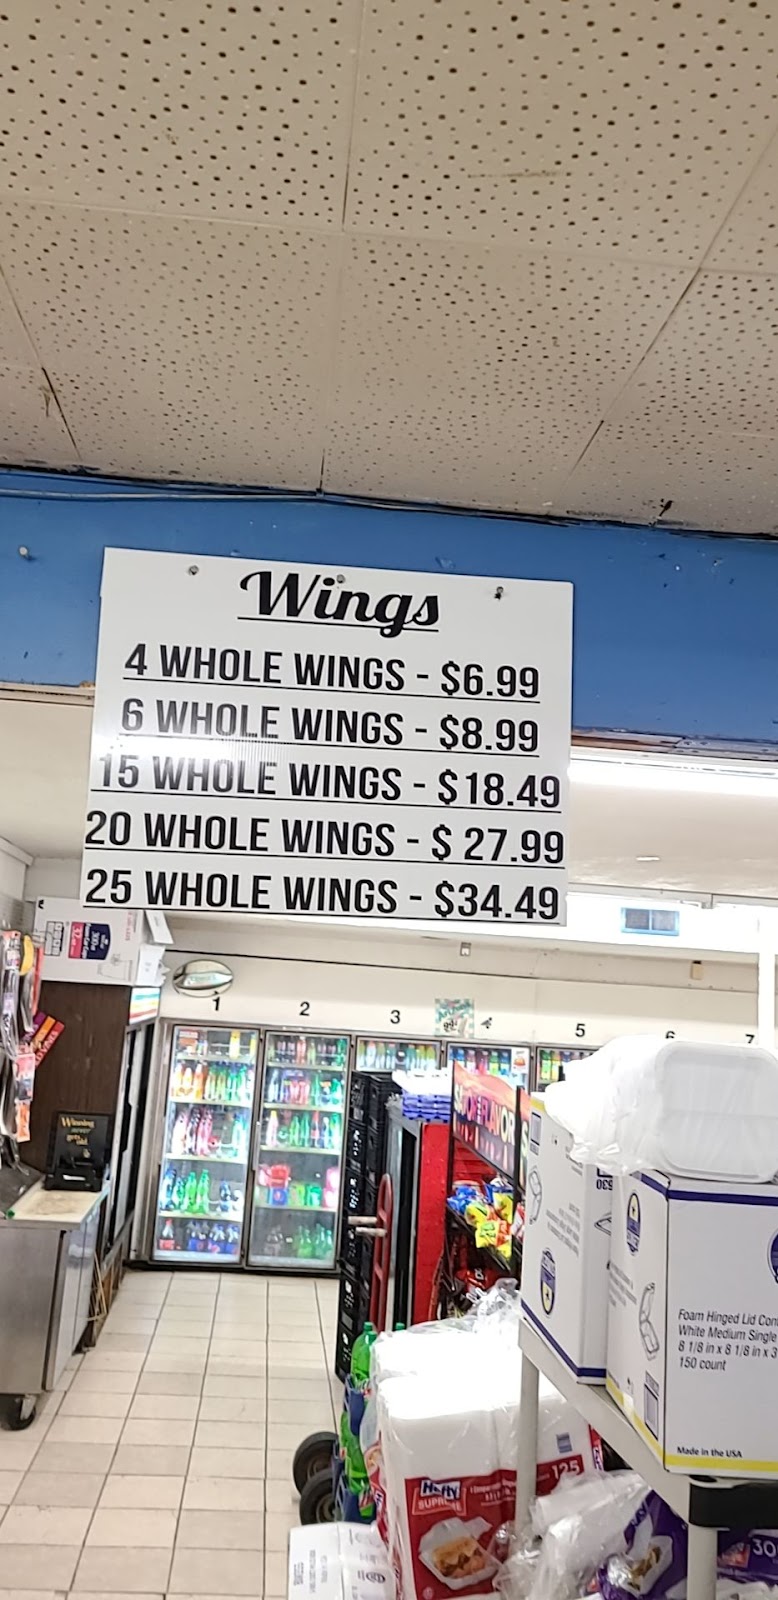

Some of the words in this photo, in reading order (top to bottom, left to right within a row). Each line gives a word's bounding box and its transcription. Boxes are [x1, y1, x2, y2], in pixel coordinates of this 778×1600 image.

[240, 571, 439, 638] Wings
[125, 644, 147, 675] 4
[160, 645, 283, 684] WHOLE
[295, 653, 406, 691] WINGS
[441, 661, 539, 698] $6.99
[119, 698, 144, 730] 6
[157, 700, 279, 739] WHOLE
[292, 708, 404, 746] WINGS
[440, 715, 538, 752] $8.99
[99, 754, 139, 788] 15
[153, 757, 277, 795] WHOLE
[289, 763, 402, 801] WINGS
[85, 811, 132, 846] 20
[145, 813, 270, 852] WHOLE
[282, 819, 396, 857] WINGS
[464, 828, 564, 864] 27.99
[86, 869, 132, 904] 25
[146, 871, 272, 910] WHOLE
[284, 877, 398, 914] WINGS
[435, 881, 559, 919] $34.49
[213, 996, 220, 1011] 1
[299, 1001, 310, 1017] 2
[390, 1009, 401, 1024] 3
[575, 1023, 586, 1038] 5
[678, 1308, 704, 1321] Foam
[707, 1310, 740, 1326] Hinged
[742, 1312, 756, 1325] Lid
[679, 1324, 706, 1338] White
[708, 1326, 746, 1341] Medium
[748, 1329, 777, 1345] Single
[678, 1340, 685, 1352] 8
[689, 1341, 704, 1354] 1/8
[706, 1342, 715, 1354] in
[717, 1345, 722, 1354] x
[725, 1343, 732, 1355] 8
[736, 1344, 750, 1357] 1/8
[752, 1345, 761, 1357] in
[763, 1348, 769, 1358] x
[771, 1346, 778, 1359] 3
[680, 1356, 697, 1369] 150
[699, 1359, 727, 1371] count
[677, 1447, 699, 1456] Made
[701, 1447, 709, 1456] in
[711, 1448, 724, 1458] the
[726, 1449, 743, 1458] USA
[752, 1538, 778, 1558] 30
